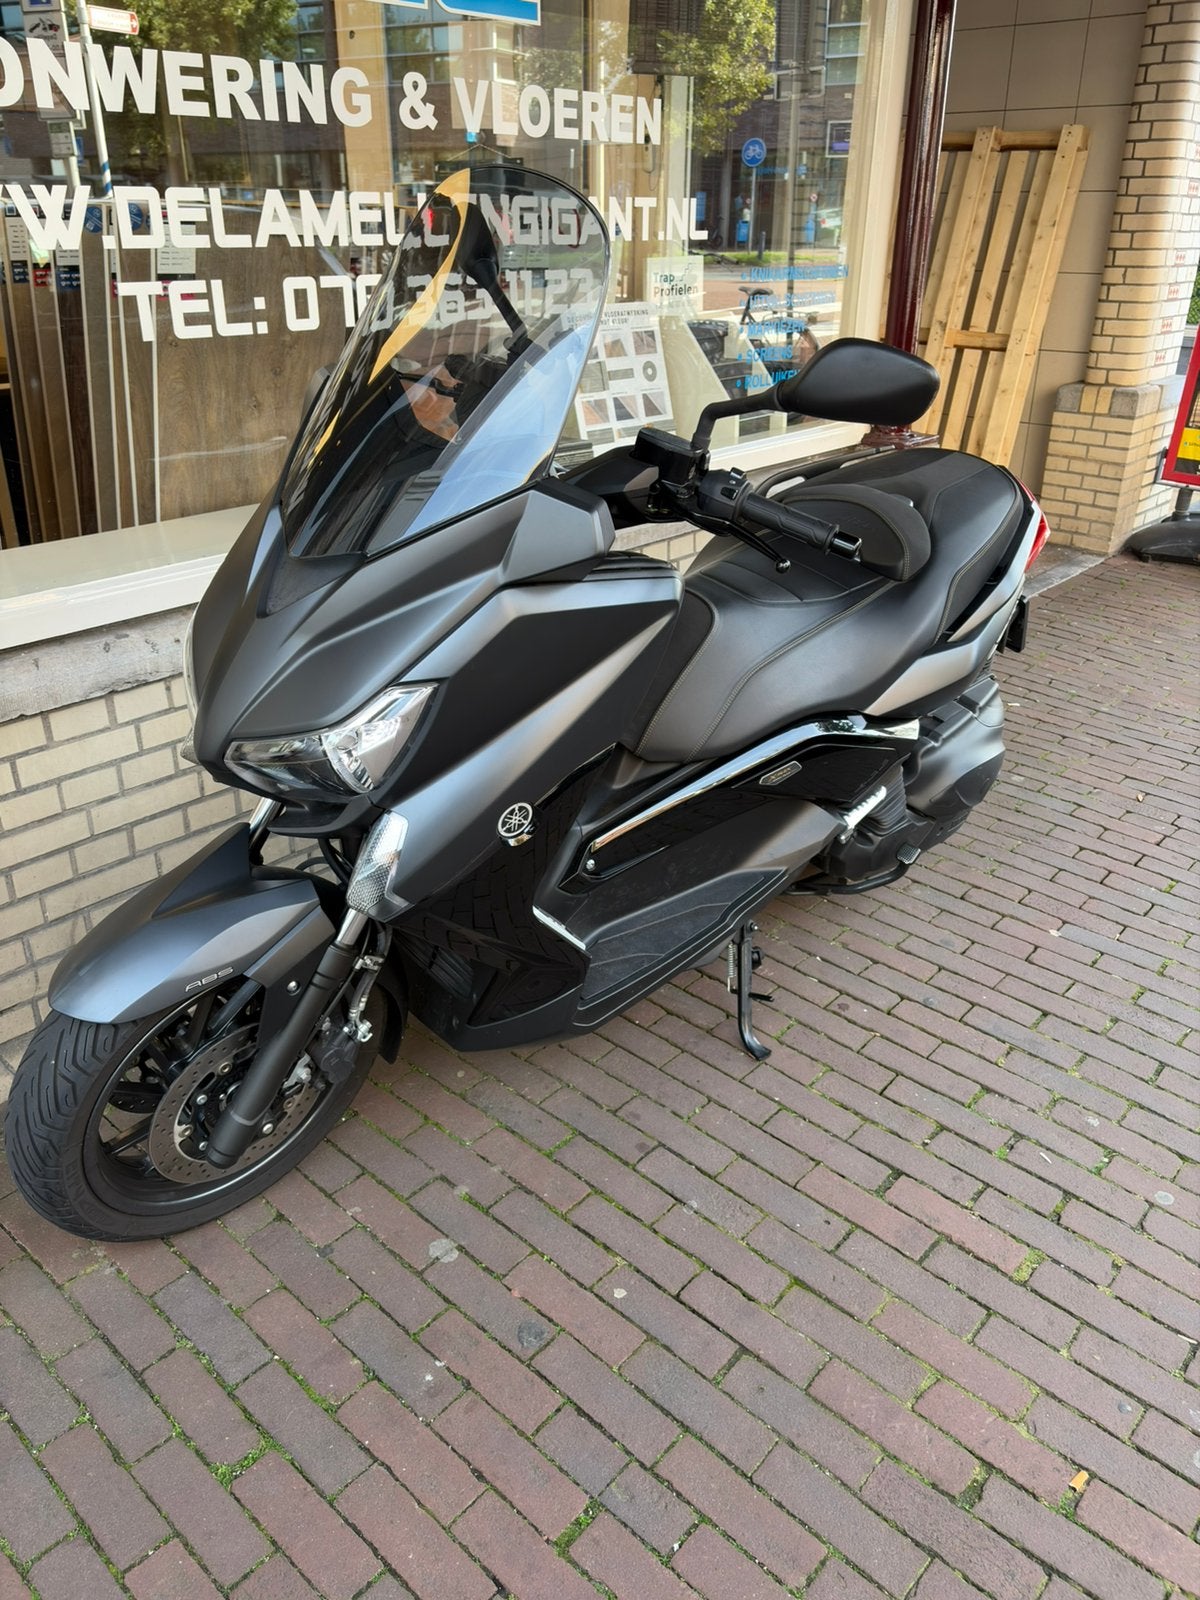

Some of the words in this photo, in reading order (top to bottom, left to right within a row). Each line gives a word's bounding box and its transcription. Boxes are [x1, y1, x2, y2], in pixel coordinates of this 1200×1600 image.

[400, 71, 438, 131] &
[454, 77, 662, 145] VLOEREN
[653, 271, 675, 285] Trap
[654, 283, 699, 299] Profielen
[117, 279, 269, 342] TEL:
[184, 966, 234, 993] ABS
